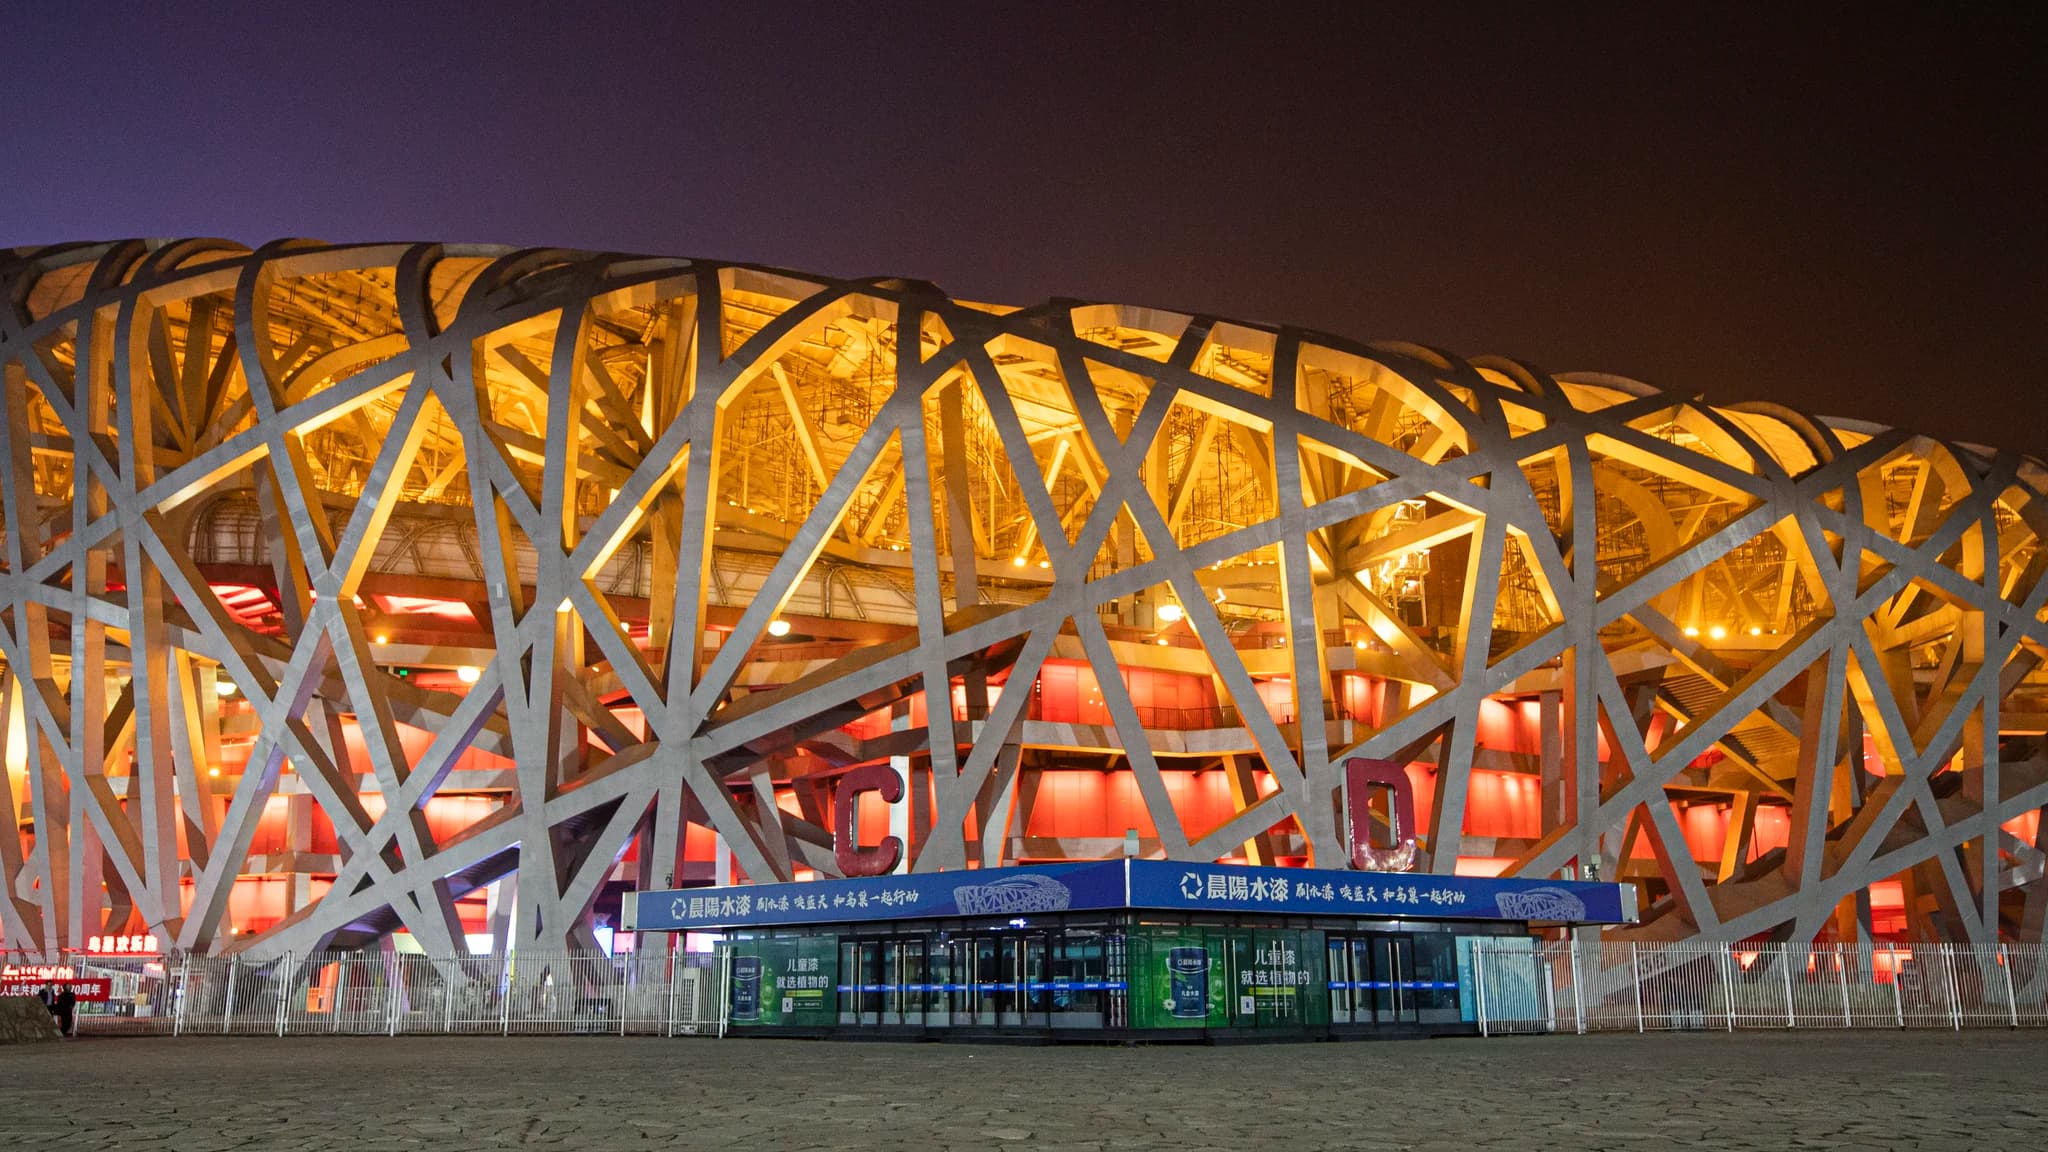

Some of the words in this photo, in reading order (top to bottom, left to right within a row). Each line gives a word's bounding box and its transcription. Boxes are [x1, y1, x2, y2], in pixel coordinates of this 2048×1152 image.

[833, 764, 906, 877] C
[1341, 757, 1417, 872] D
[688, 894, 751, 919] 晨陽水漆
[833, 888, 919, 908] 和鸟巢一起行动
[1207, 874, 1289, 902] 晨陽水漆
[1382, 885, 1466, 905] 和鸟巢一起行动
[786, 957, 819, 972] 儿童漆
[1240, 970, 1310, 985] 就选植物的
[776, 975, 829, 989] 就选植物的
